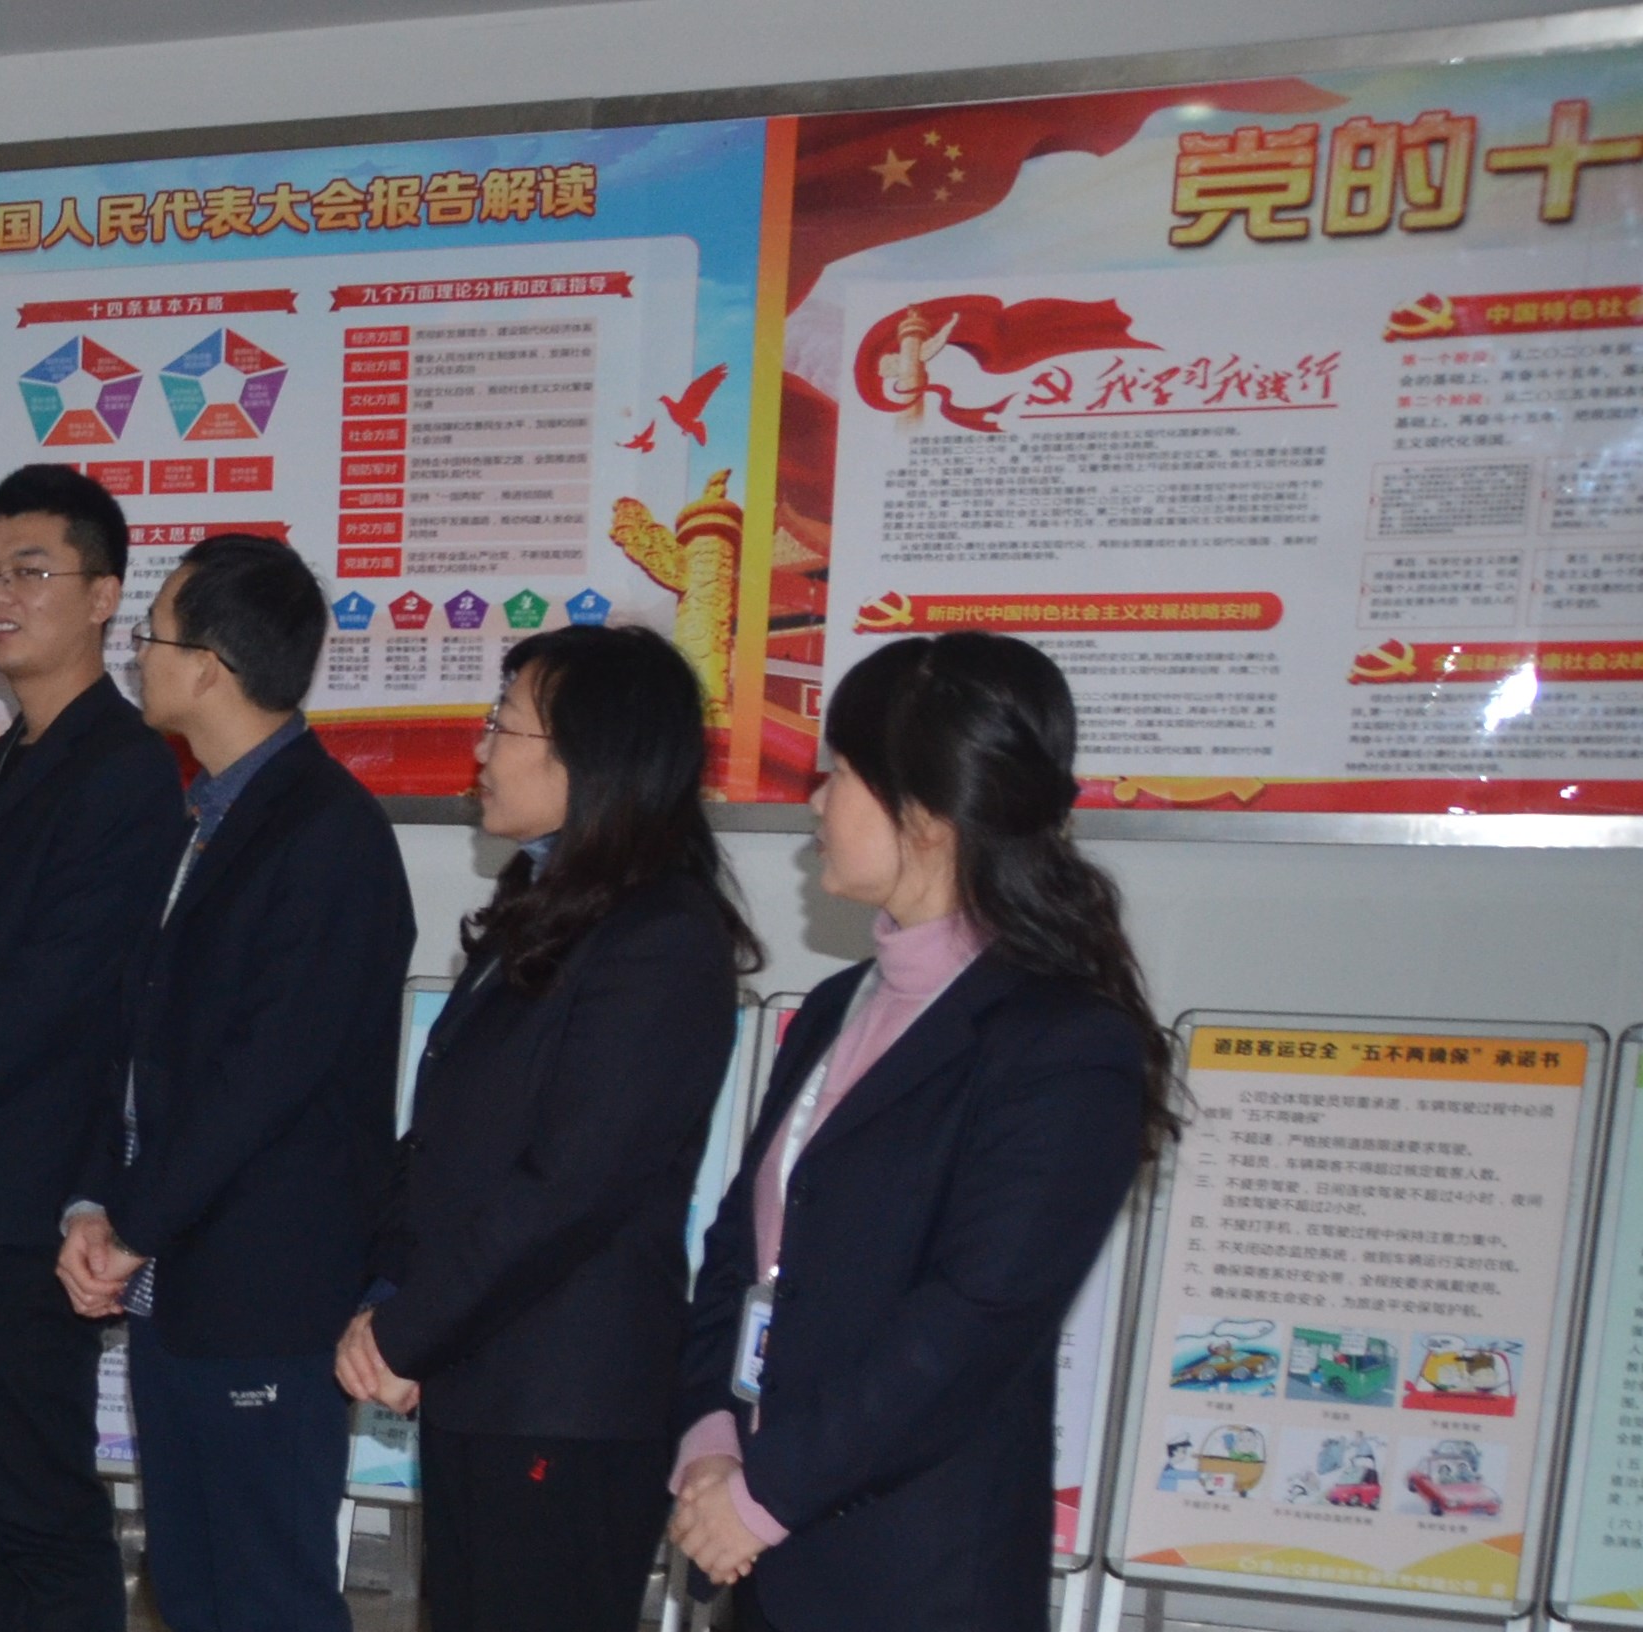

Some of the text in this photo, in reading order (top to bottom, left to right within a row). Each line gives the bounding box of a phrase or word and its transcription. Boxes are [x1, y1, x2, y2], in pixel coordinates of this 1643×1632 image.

[1168, 101, 1643, 246] 党的十
[362, 276, 607, 304] 九个方面理论分析和政策指导
[87, 296, 225, 318] 十四条基本方略
[130, 526, 206, 543] 重大思想
[926, 603, 1261, 622] 新时代中国特色社会主义发展战略安排
